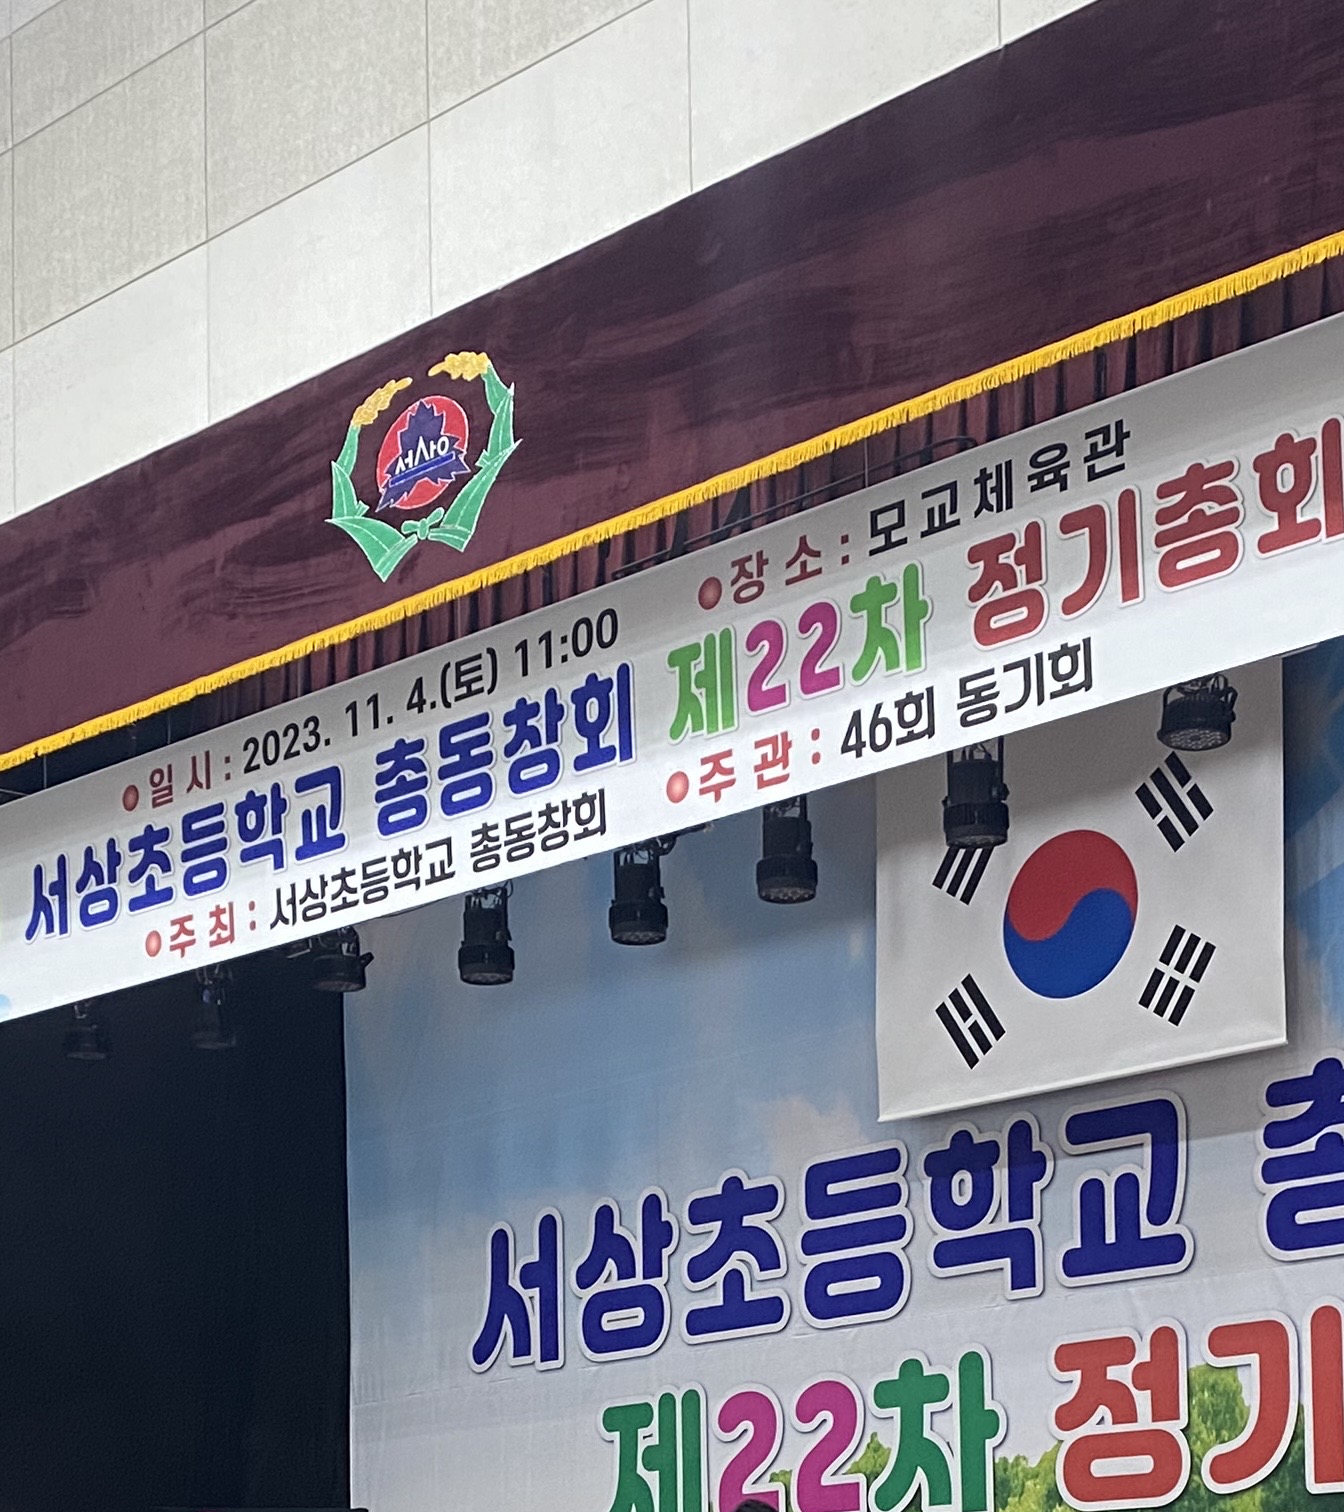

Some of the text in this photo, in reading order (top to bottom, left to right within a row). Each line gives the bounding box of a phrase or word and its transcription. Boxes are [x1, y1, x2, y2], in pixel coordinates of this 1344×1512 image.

[25, 765, 346, 942] 서상초등학교
[374, 662, 635, 837] 총동창회
[667, 561, 932, 744] 제22차
[243, 715, 331, 775] 2023.
[344, 698, 396, 741] 11.
[513, 607, 620, 679] 11:00
[868, 418, 1132, 557] 모교체육관
[270, 836, 455, 930] 서상초등학교
[469, 788, 608, 872] 총동창회
[840, 685, 936, 759] 46회
[956, 636, 1094, 729] 동기회
[471, 1097, 1190, 1366] 서상초등학교
